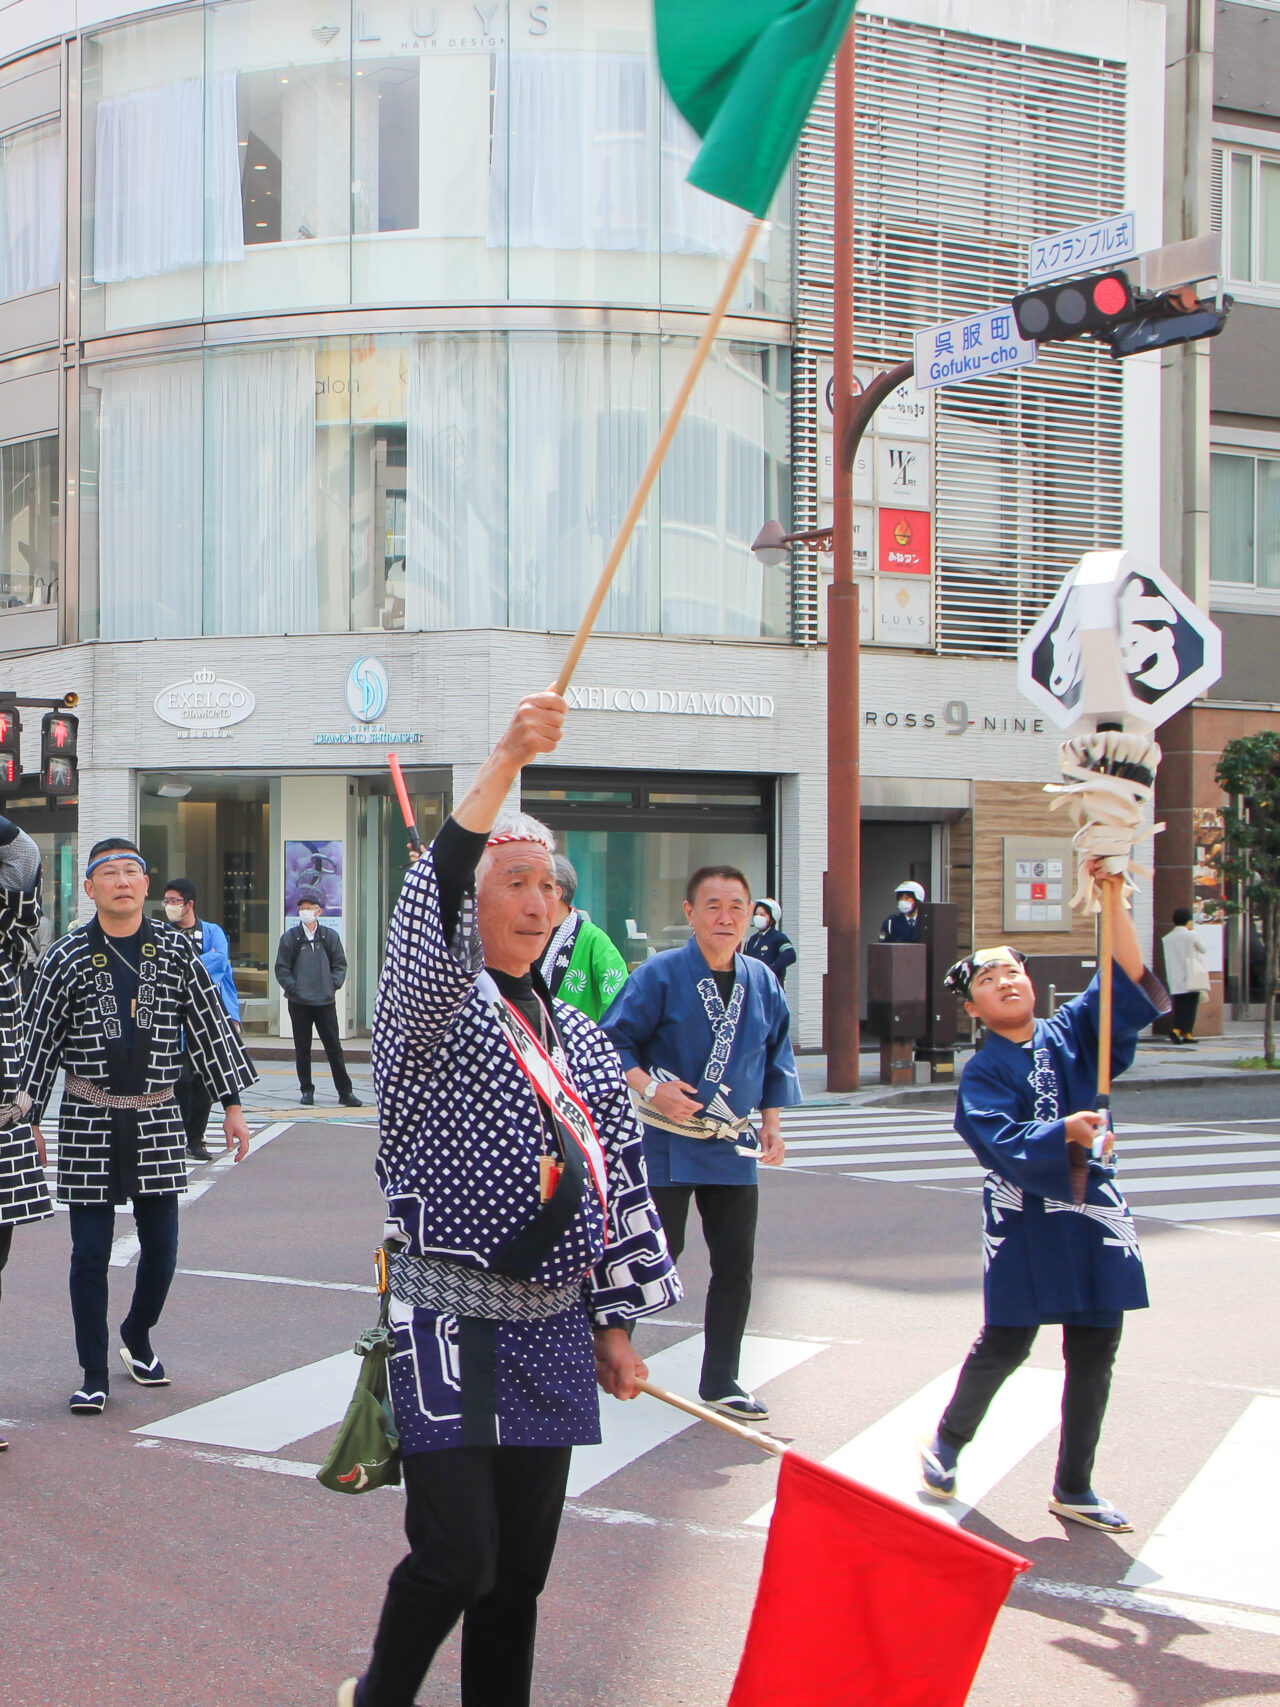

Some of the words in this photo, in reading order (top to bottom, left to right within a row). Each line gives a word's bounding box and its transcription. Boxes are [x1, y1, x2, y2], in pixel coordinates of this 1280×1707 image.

[356, 3, 551, 42] LUYS
[401, 39, 438, 49] HAIR
[1035, 222, 1130, 272] スクランブル式
[933, 314, 1012, 359] 呉服町
[929, 342, 1018, 382] Gofuku-cho
[881, 612, 926, 626] LUYS
[167, 691, 246, 709] EXELCO
[569, 687, 649, 712] XELCO
[656, 691, 775, 717] DIAMOND
[181, 709, 231, 719] DIAMOND
[865, 711, 936, 728] ROSS
[984, 716, 1045, 733] NINE
[350, 724, 385, 733] GINZA
[314, 734, 367, 744] DIAMOND
[369, 734, 423, 744] SHIRAISHI
